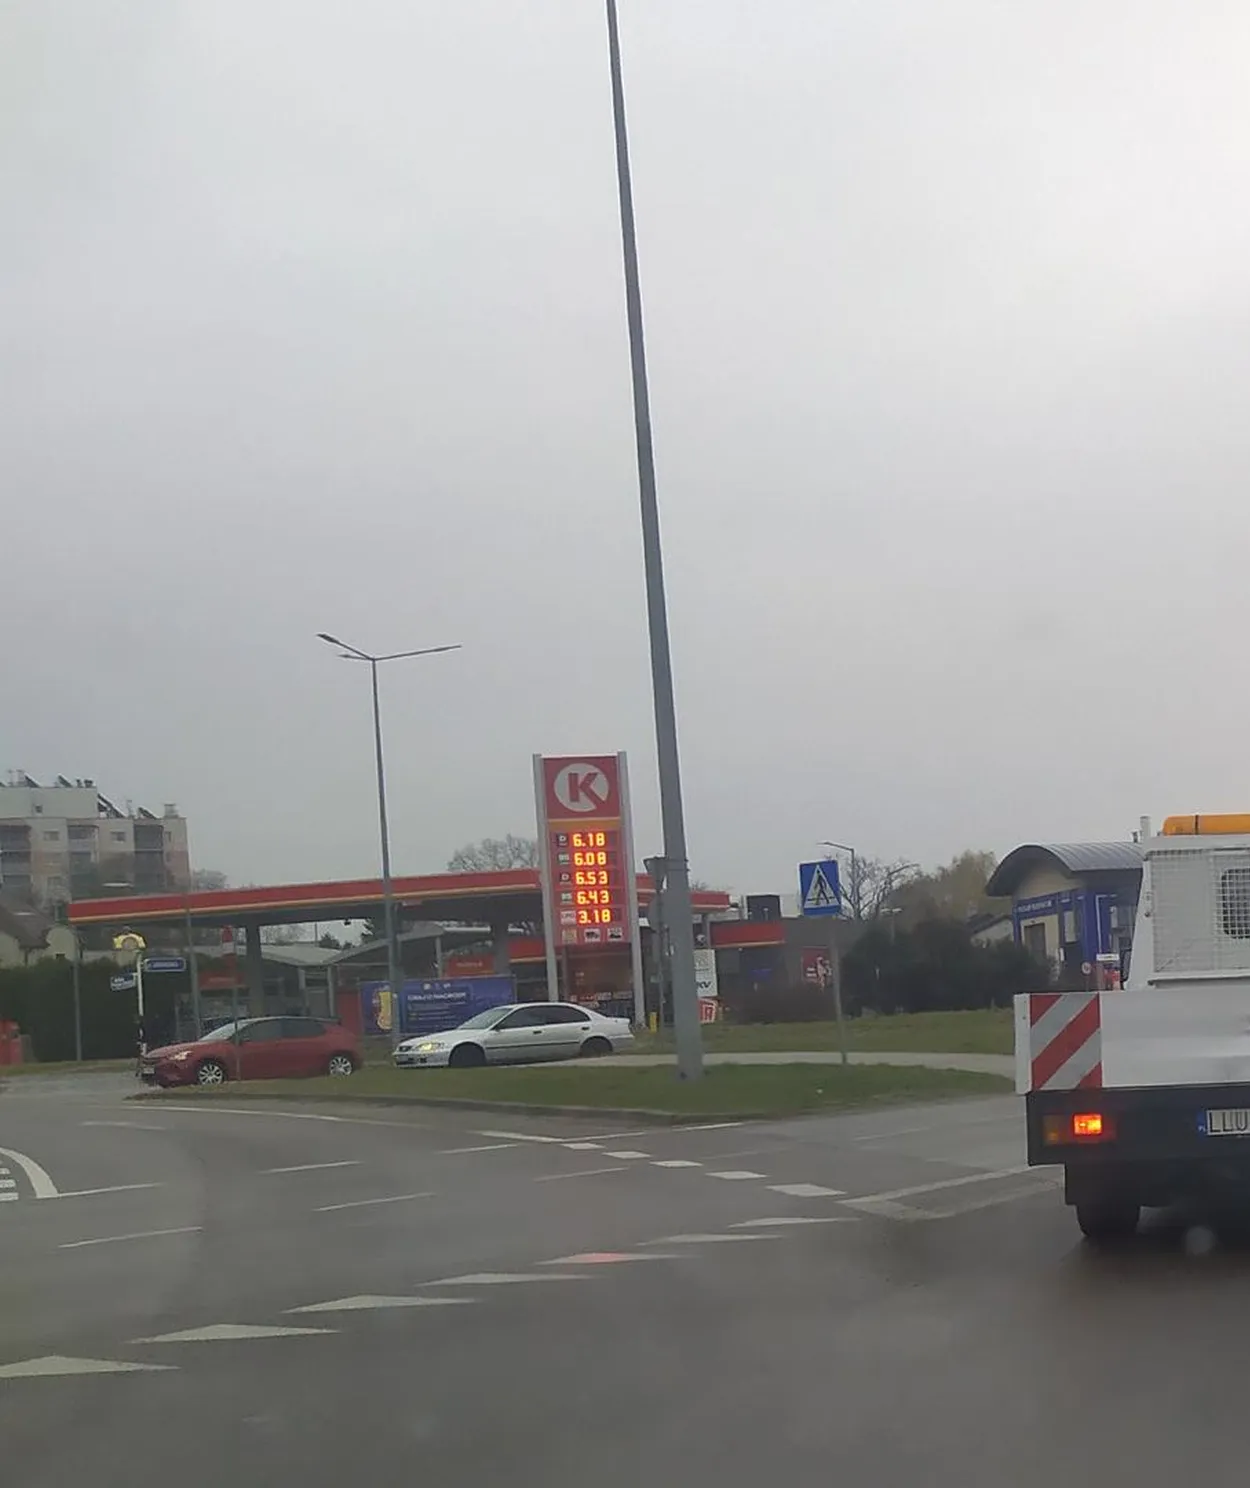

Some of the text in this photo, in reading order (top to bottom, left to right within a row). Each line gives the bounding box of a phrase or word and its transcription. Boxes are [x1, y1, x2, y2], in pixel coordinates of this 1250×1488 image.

[565, 770, 605, 805] K
[573, 833, 605, 847] 6.18
[574, 852, 607, 866] 6.08
[575, 871, 608, 885] 6.53
[577, 890, 609, 904] 6.43
[578, 909, 611, 924] 3.18
[1209, 1111, 1248, 1133] LLU
